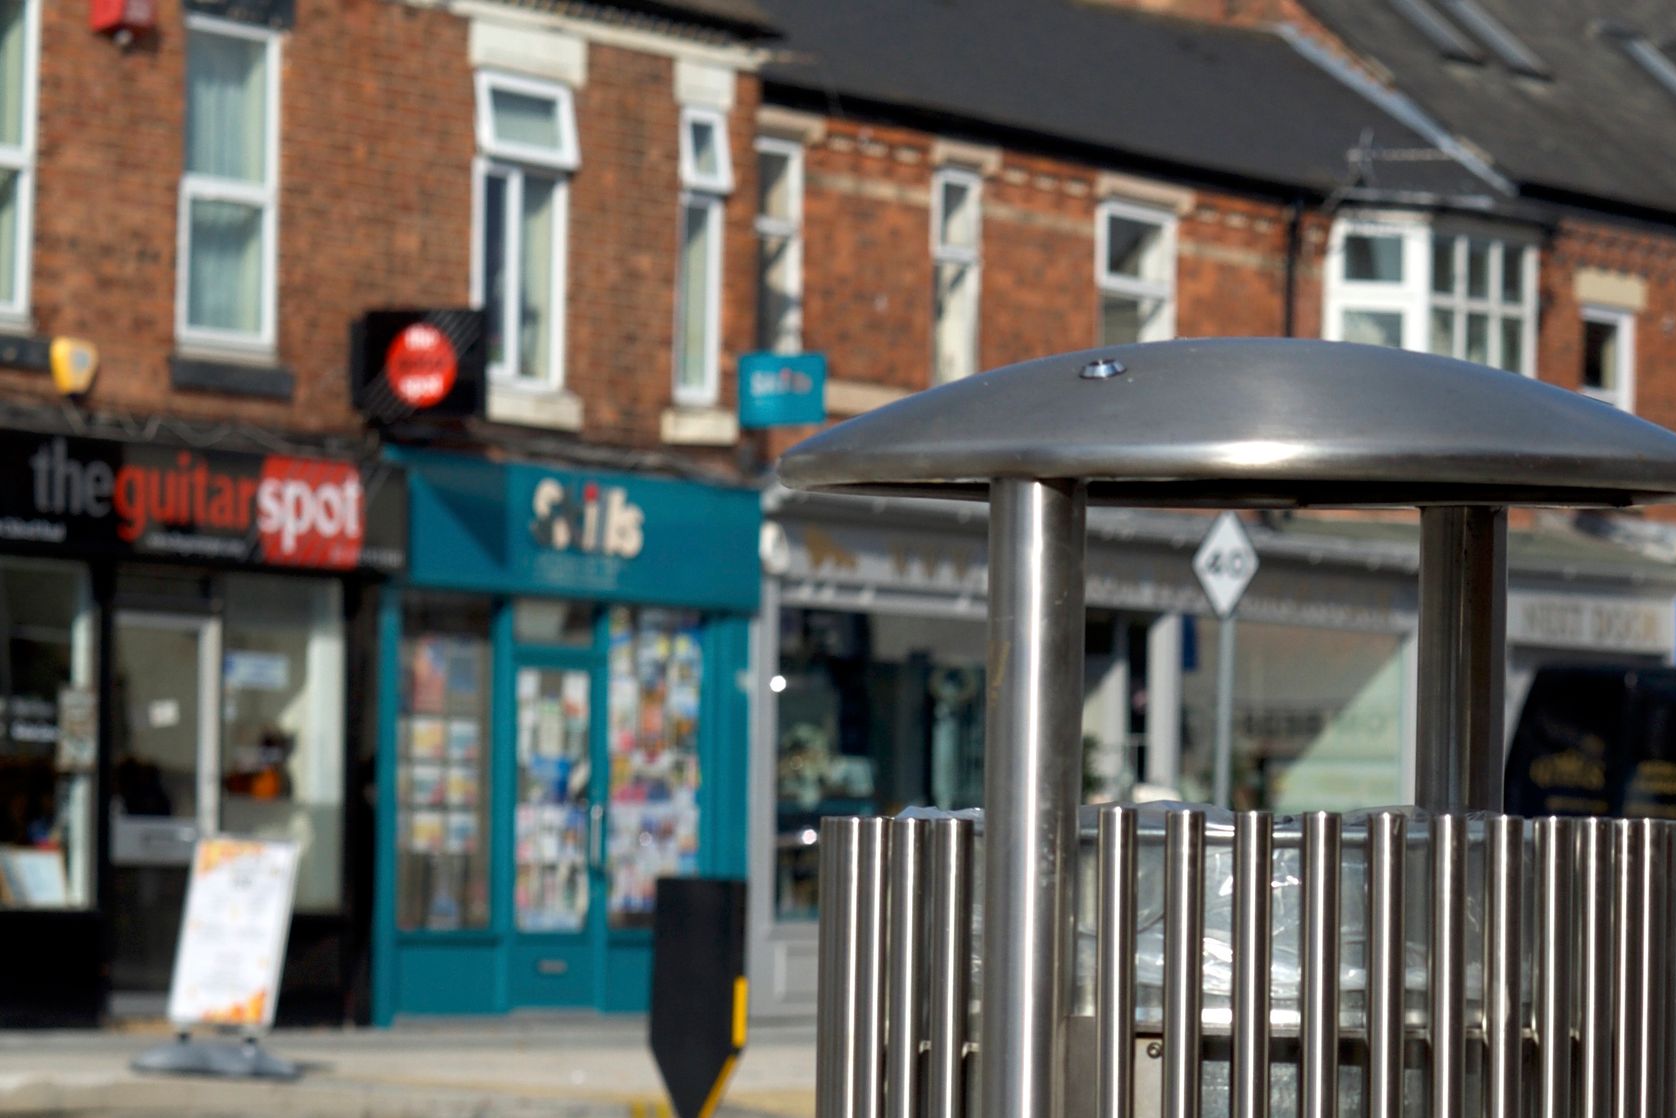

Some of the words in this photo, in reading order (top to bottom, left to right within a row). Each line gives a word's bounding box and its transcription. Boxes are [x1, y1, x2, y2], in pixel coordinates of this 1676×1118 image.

[29, 436, 115, 518] the
[114, 451, 258, 542] guitar
[256, 471, 364, 556] spot
[1204, 552, 1247, 579] 40
